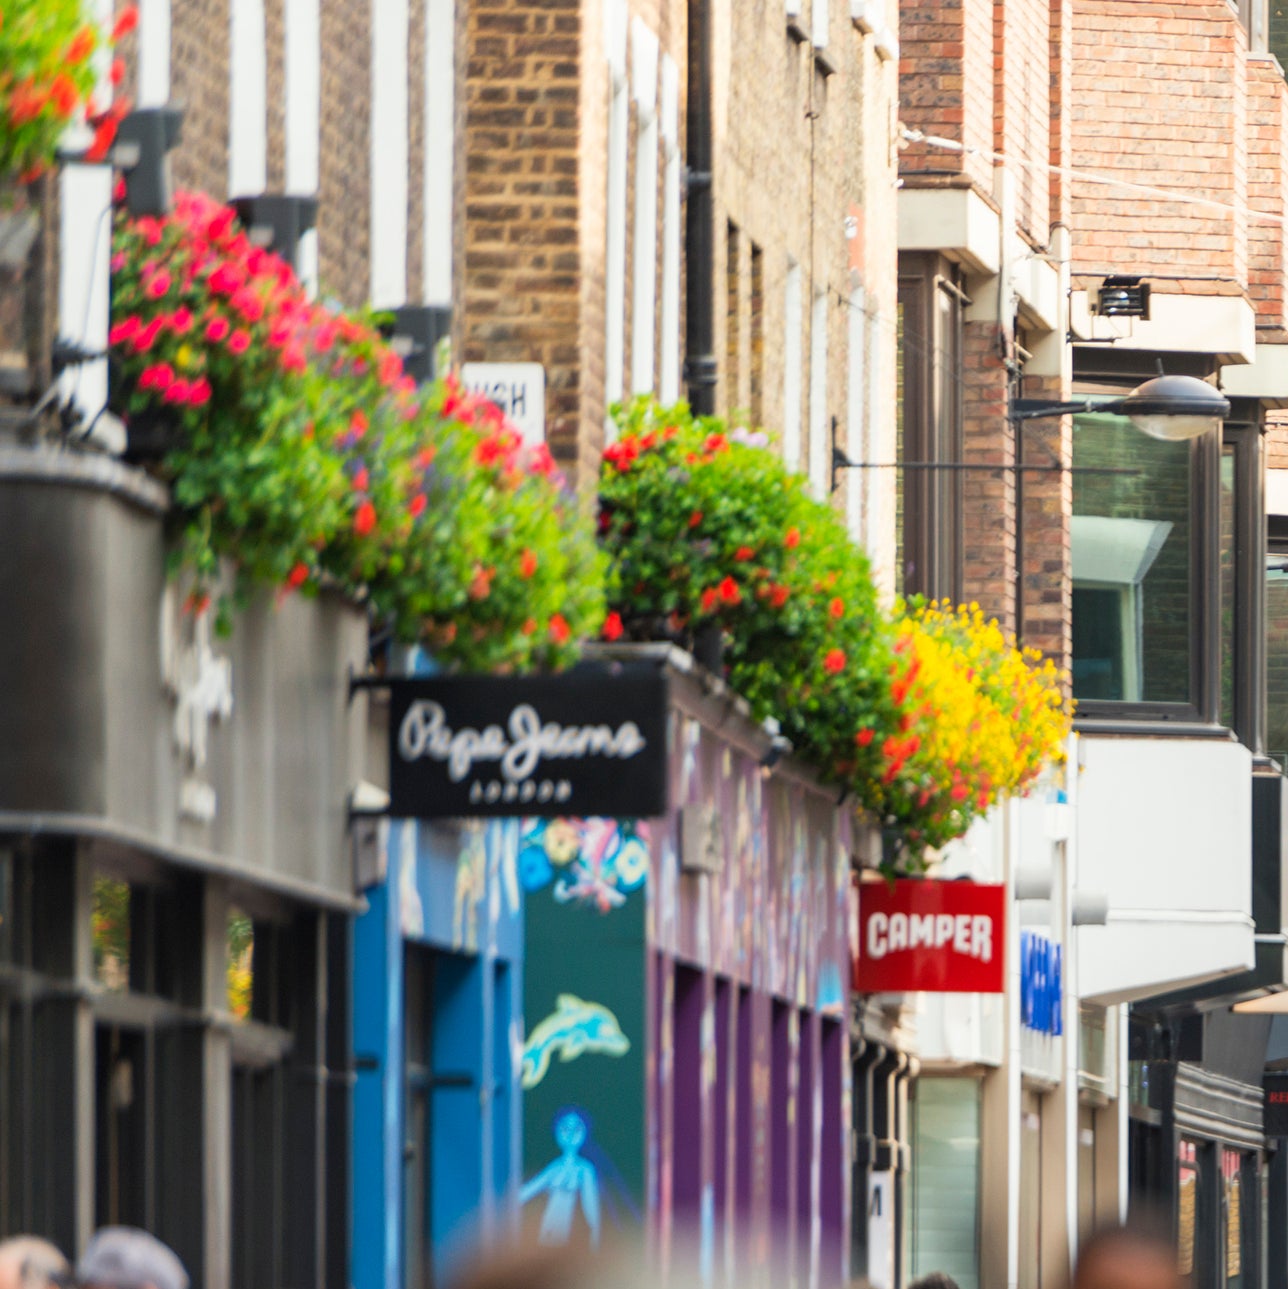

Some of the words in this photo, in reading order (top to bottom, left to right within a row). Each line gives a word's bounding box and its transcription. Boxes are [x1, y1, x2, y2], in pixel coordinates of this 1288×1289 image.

[398, 698, 508, 783] Pepe
[501, 702, 647, 782] Jeans
[867, 911, 993, 964] CAMPER
